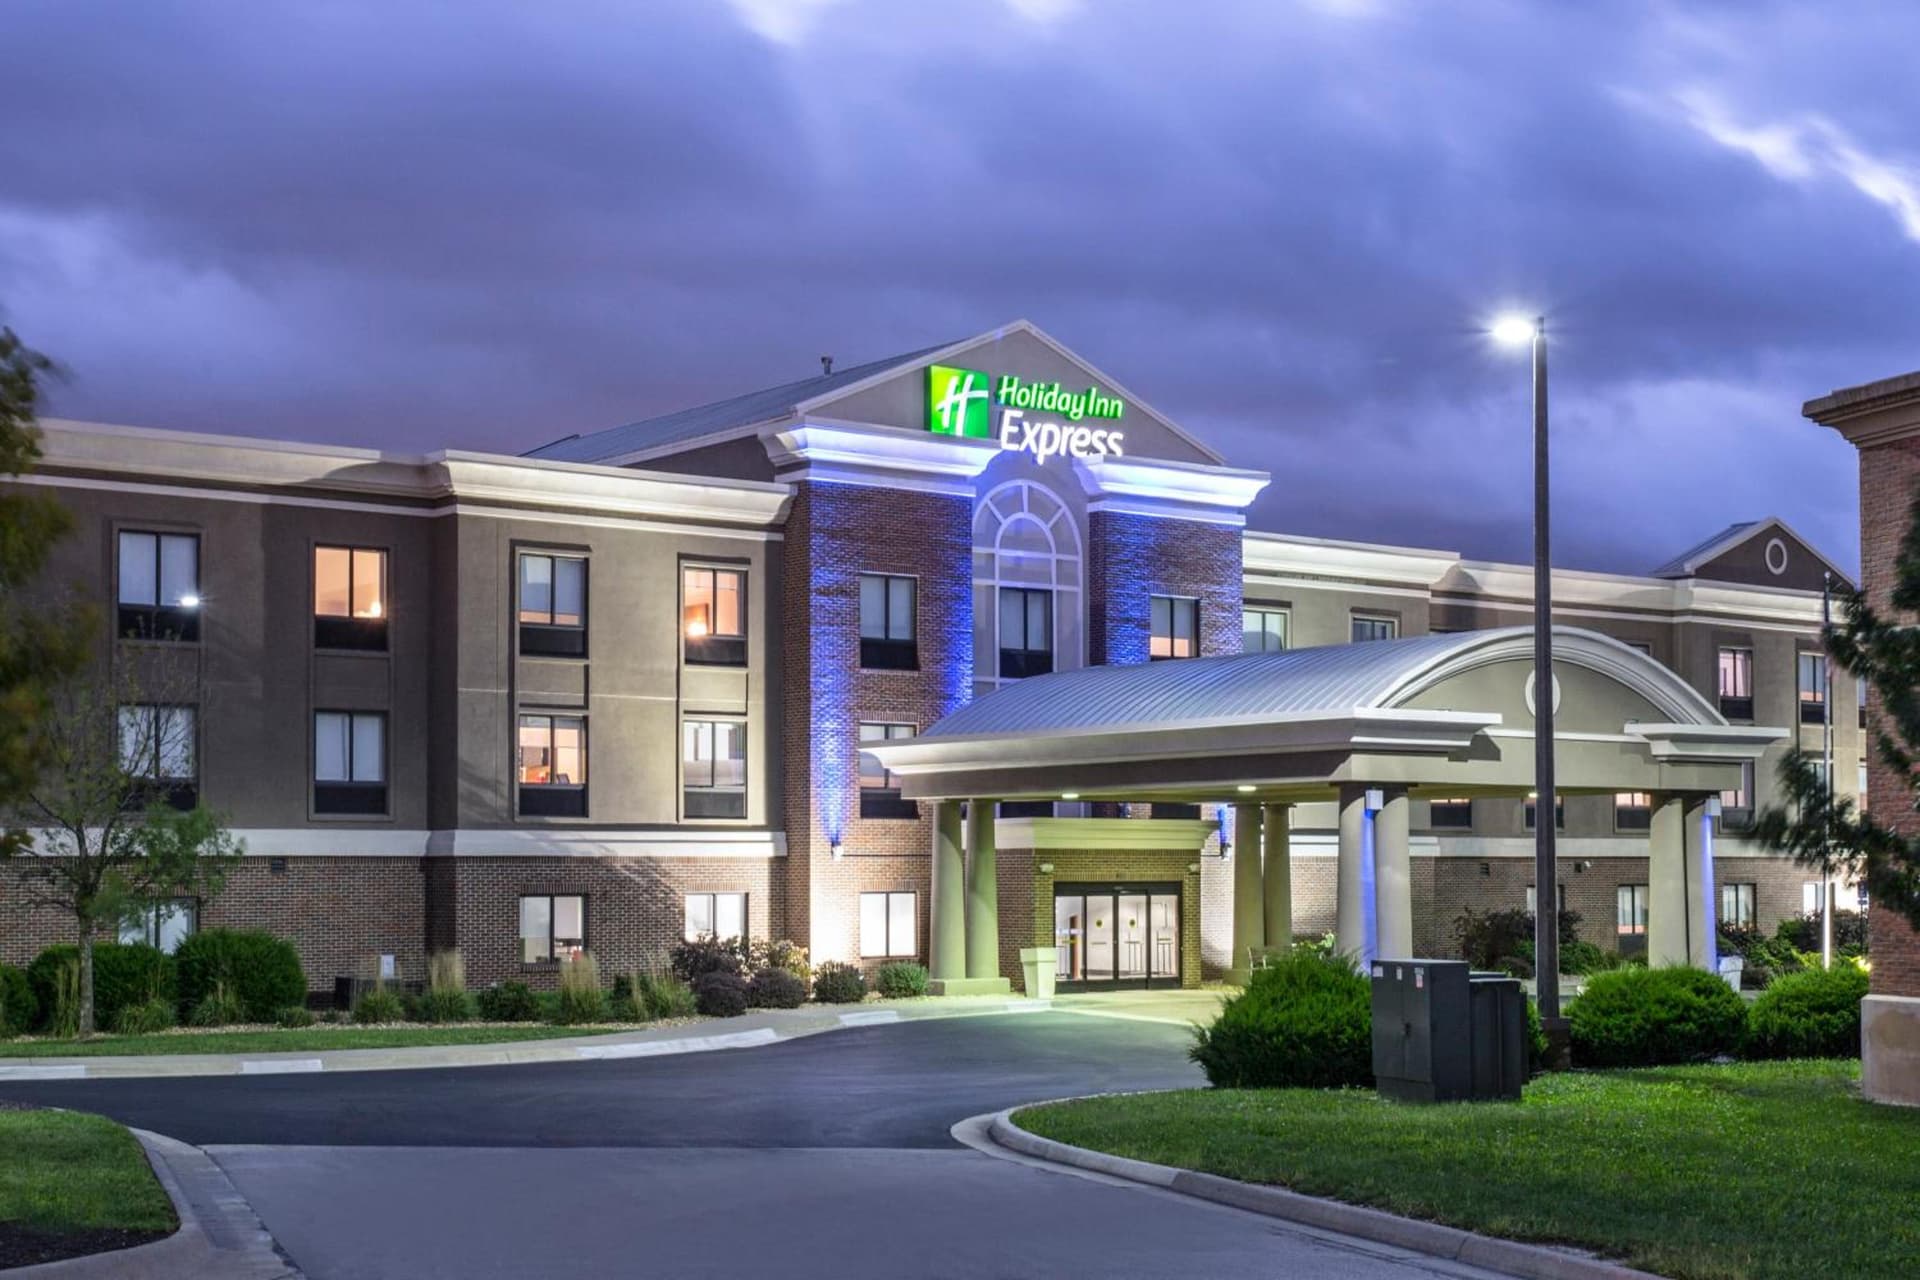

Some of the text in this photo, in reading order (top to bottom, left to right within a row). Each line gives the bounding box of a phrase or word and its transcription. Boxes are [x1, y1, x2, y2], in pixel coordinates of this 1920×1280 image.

[998, 375, 1124, 420] Holiday Inn
[1000, 408, 1124, 465] Express
